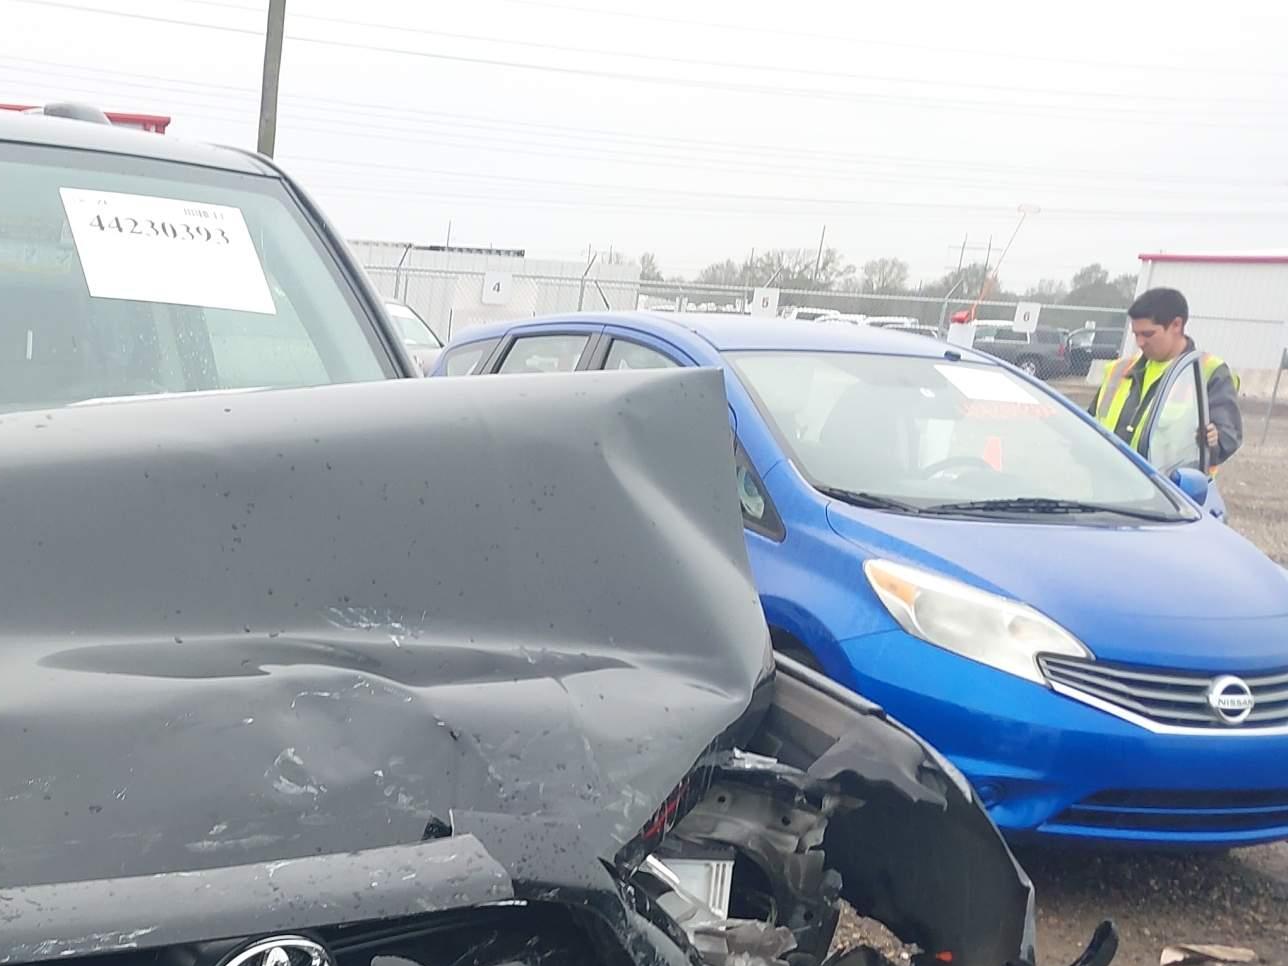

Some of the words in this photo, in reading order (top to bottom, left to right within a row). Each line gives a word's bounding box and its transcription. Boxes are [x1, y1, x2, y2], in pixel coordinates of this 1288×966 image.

[89, 214, 230, 245] 44230393
[492, 281, 501, 292] 4
[1217, 697, 1252, 707] NISSAN
